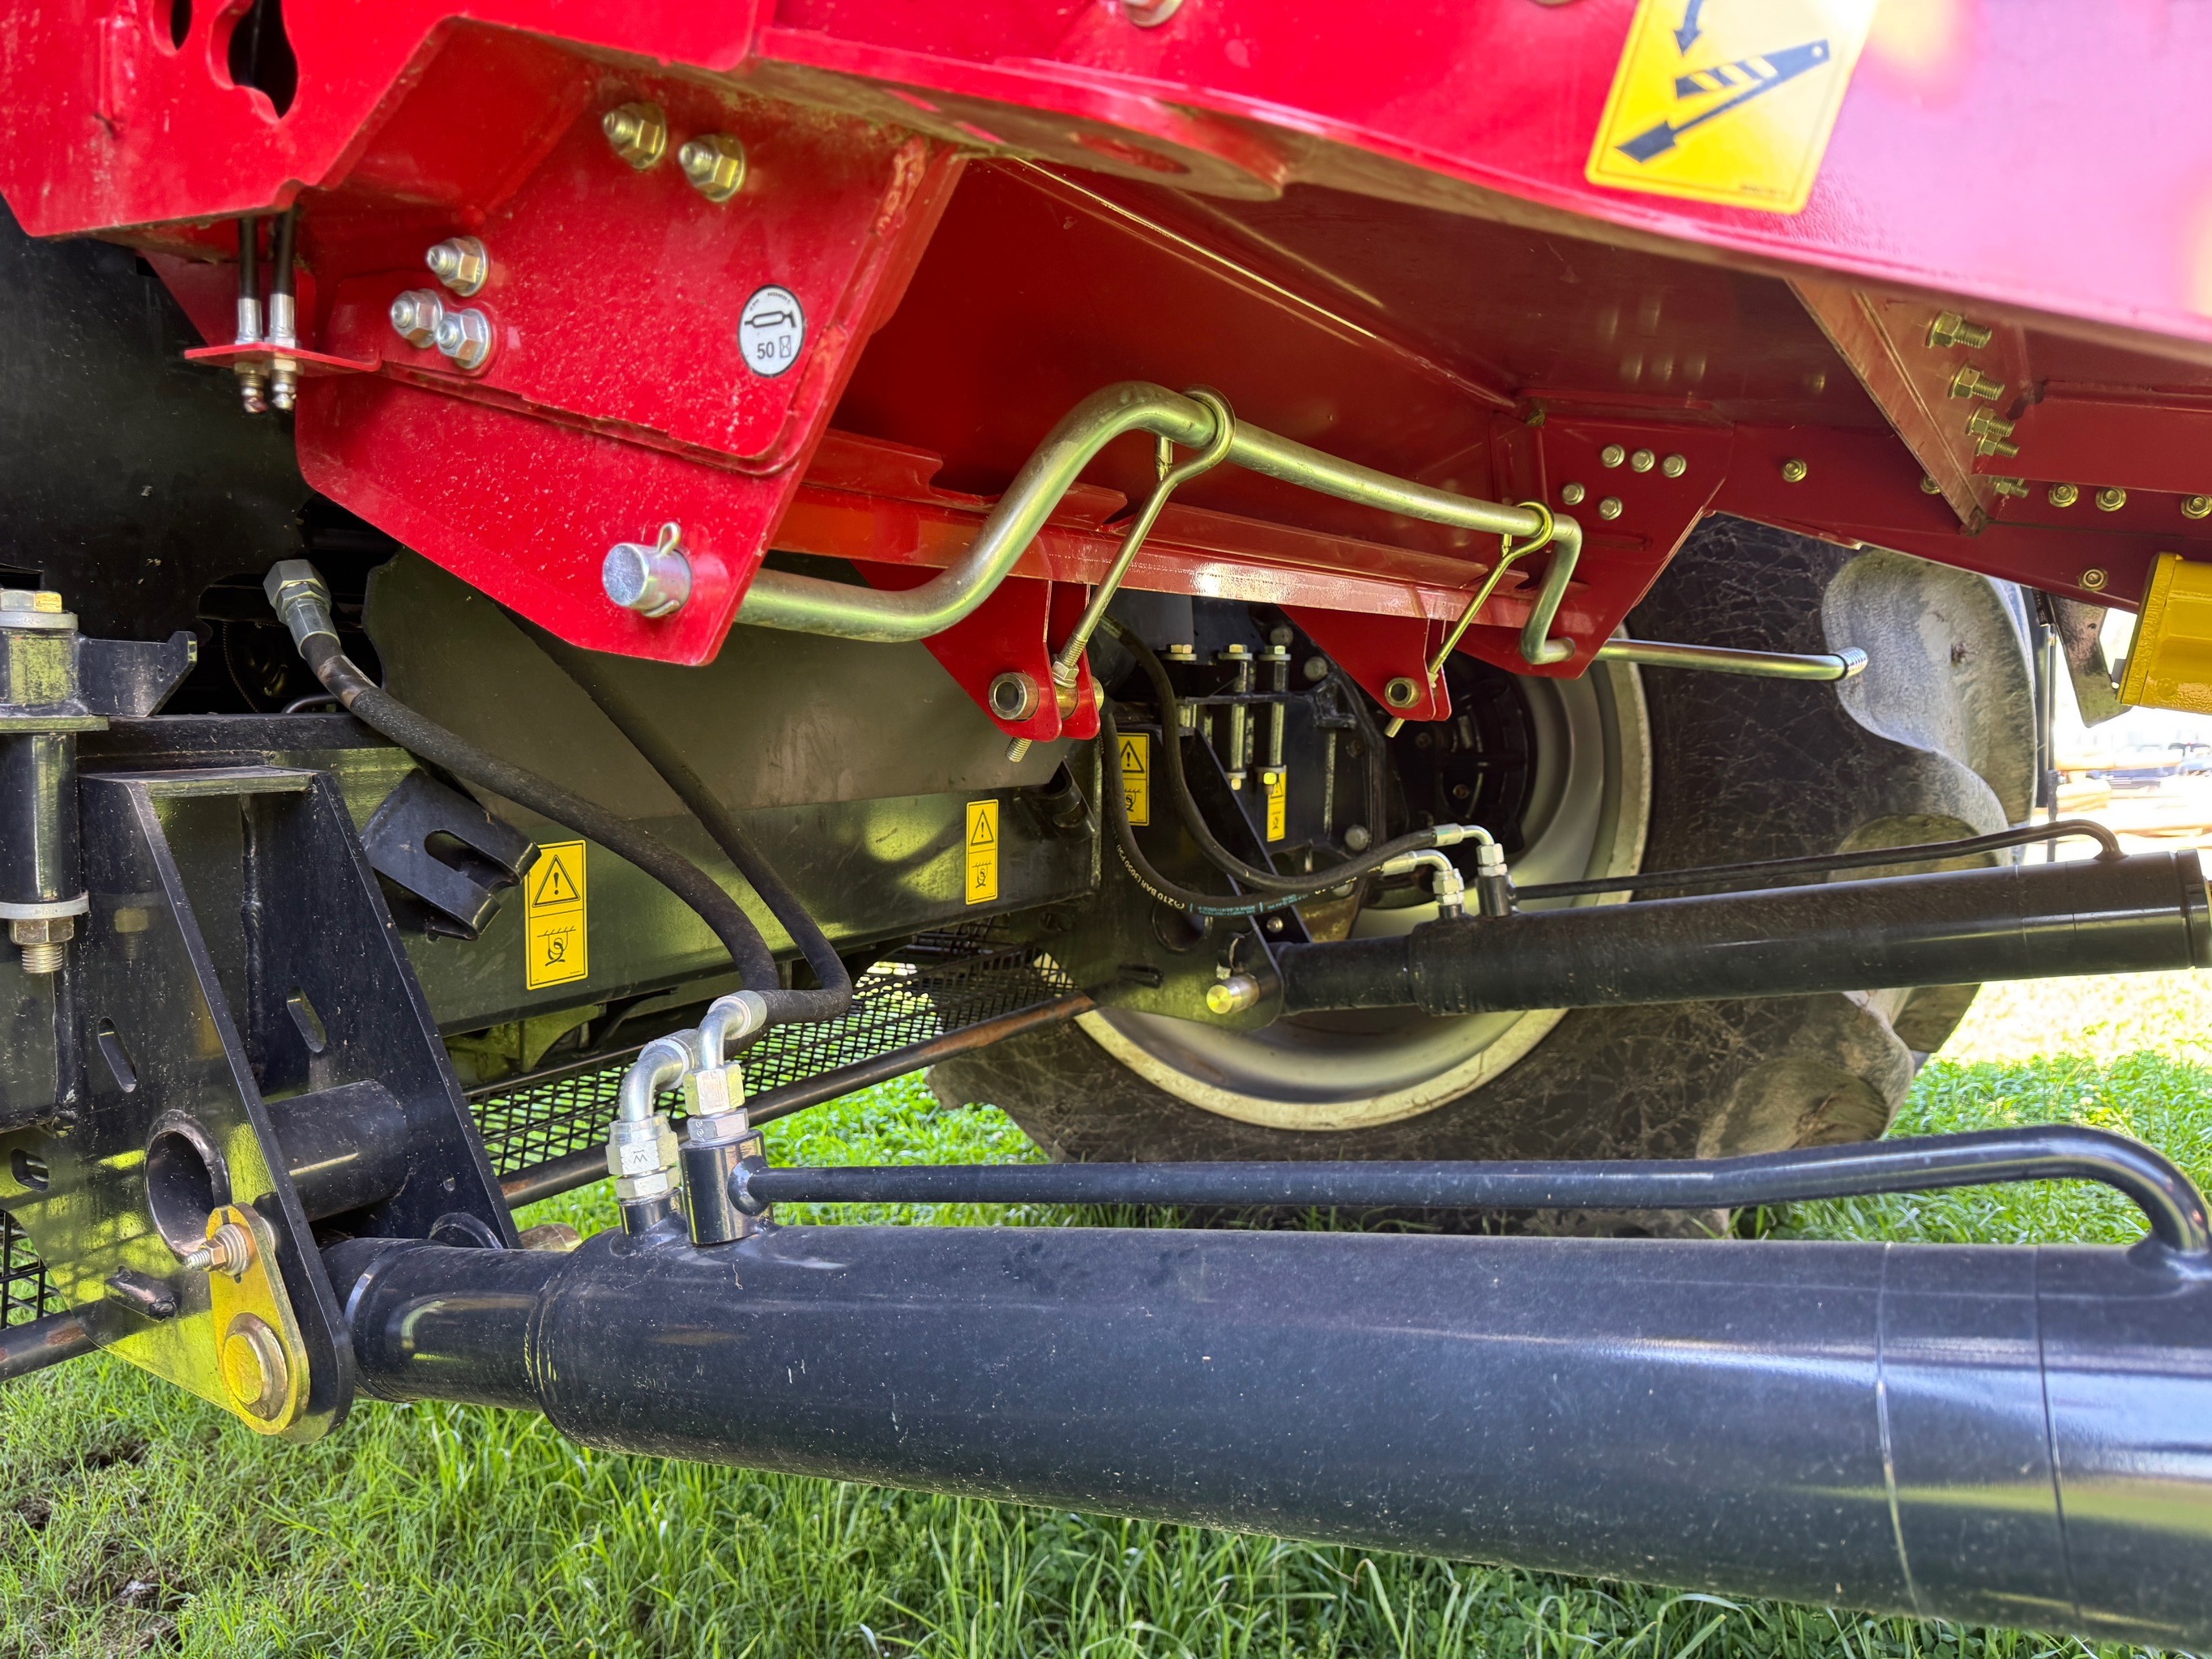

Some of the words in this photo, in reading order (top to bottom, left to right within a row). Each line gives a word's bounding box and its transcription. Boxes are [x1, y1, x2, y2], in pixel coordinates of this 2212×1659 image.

[757, 341, 775, 360] 50
[1141, 880, 1157, 897] BAR
[1157, 893, 1174, 906] 210
